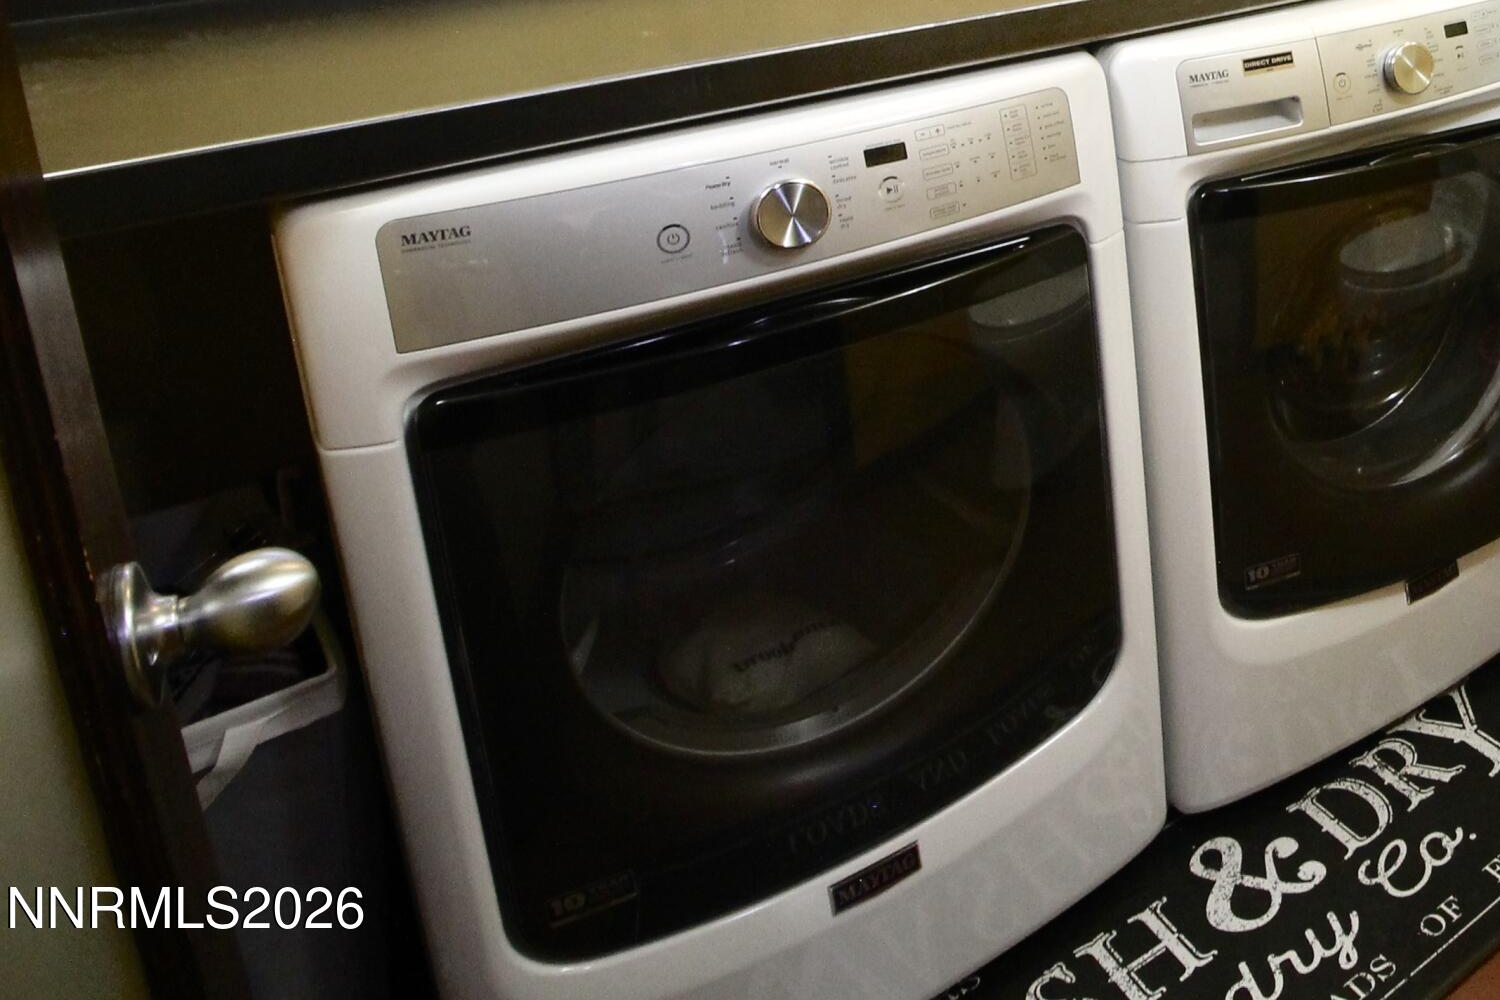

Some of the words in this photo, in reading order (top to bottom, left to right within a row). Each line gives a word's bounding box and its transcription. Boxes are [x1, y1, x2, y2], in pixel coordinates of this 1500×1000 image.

[1188, 69, 1230, 84] MAYTAG
[1244, 58, 1270, 69] DIRECT
[1271, 55, 1292, 65] DRIVE
[401, 226, 471, 246] MAYTAG
[1358, 826, 1477, 898] Co.
[1189, 835, 1327, 933] &
[1419, 895, 1464, 937] OF
